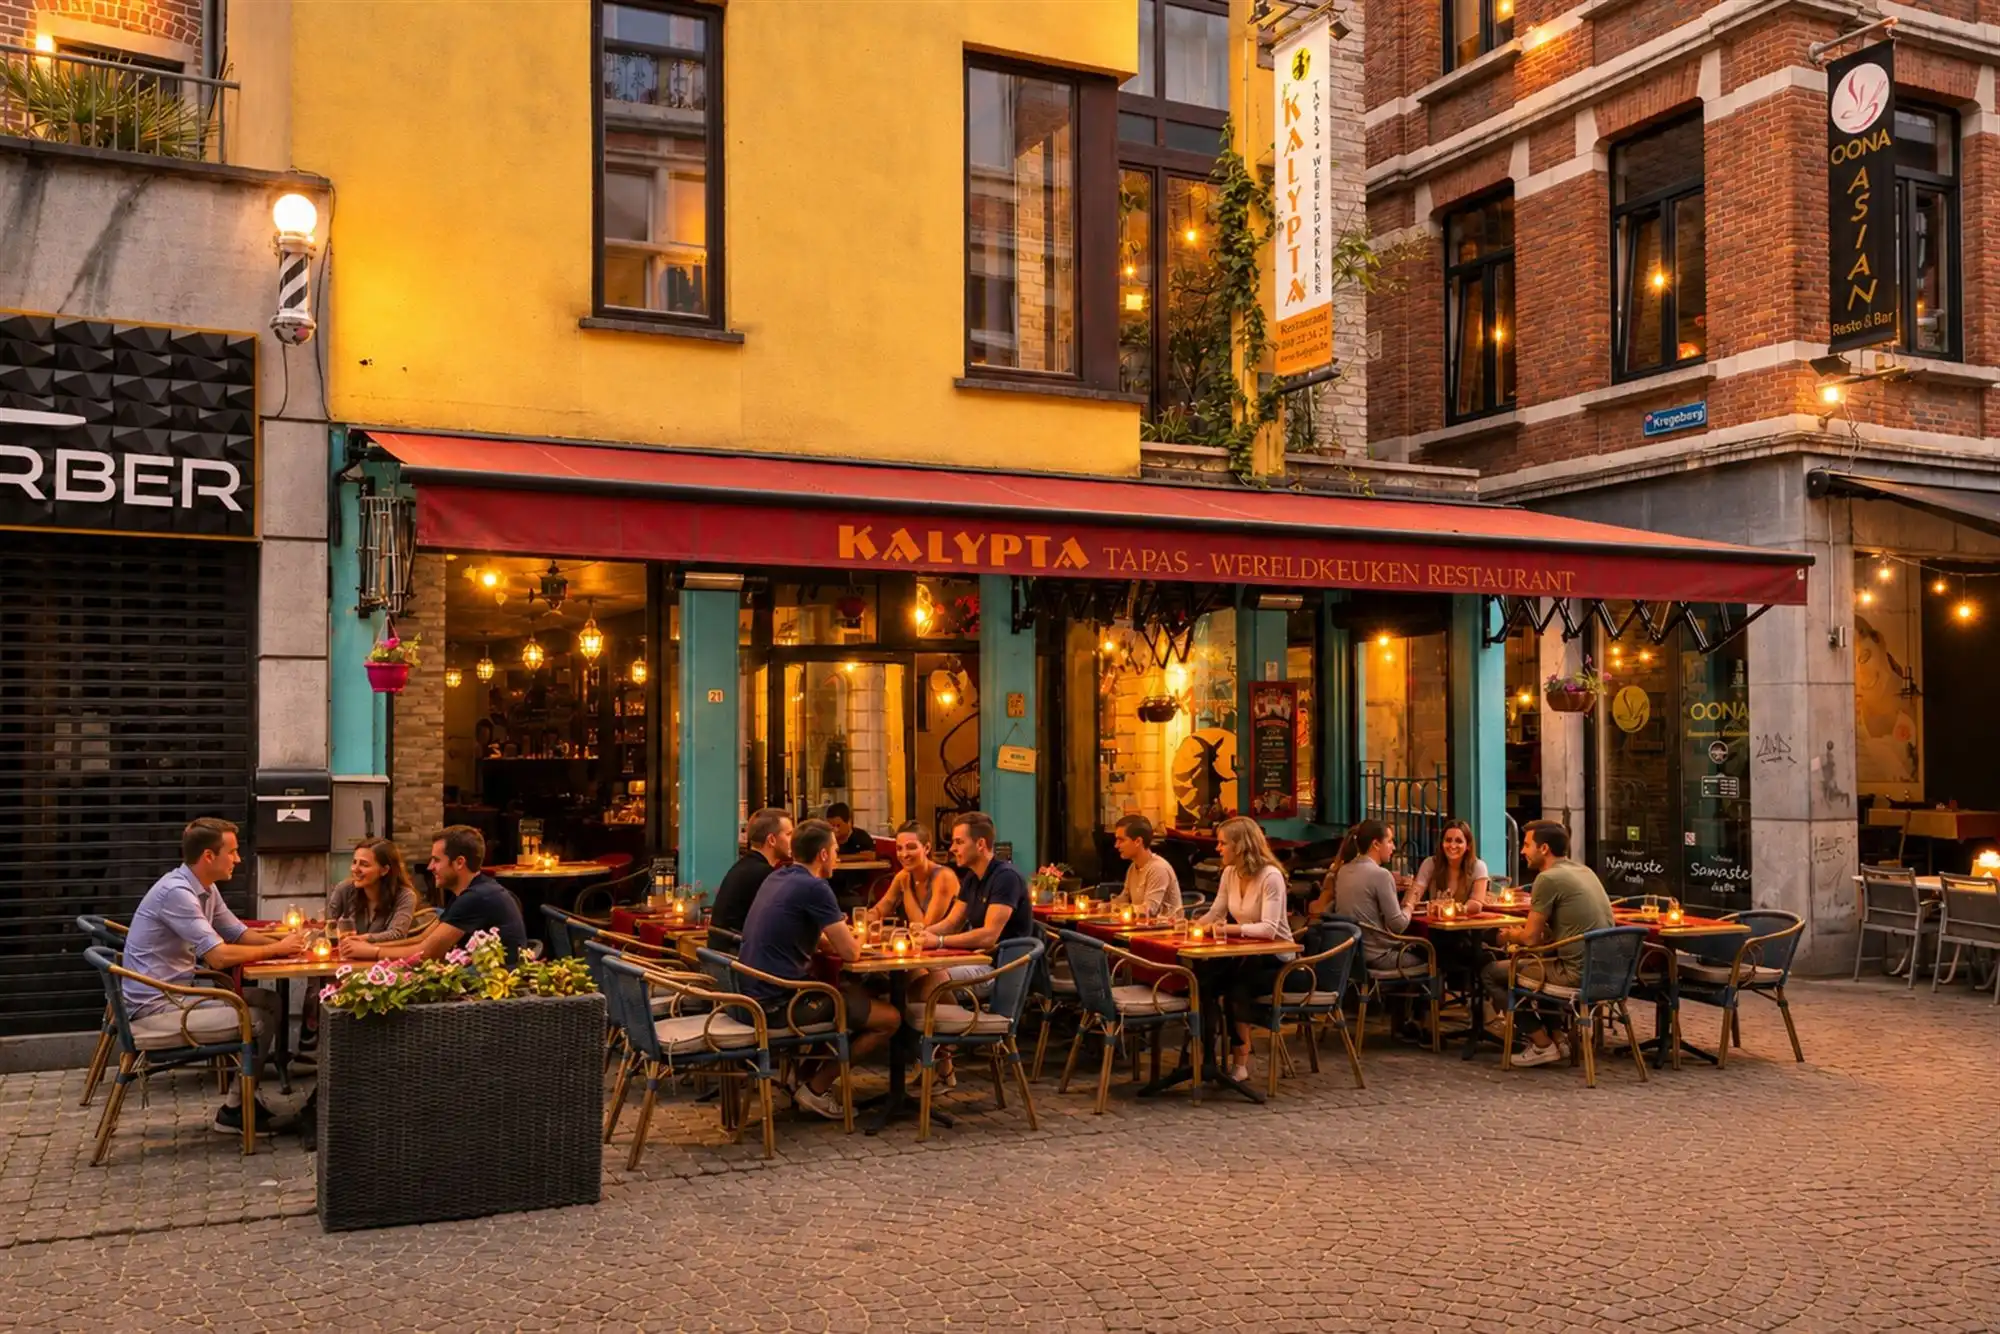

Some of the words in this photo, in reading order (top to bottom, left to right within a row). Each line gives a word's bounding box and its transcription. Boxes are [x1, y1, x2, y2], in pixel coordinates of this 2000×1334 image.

[1830, 128, 1892, 165] OONA
[1283, 92, 1306, 308] KALYPTA
[1847, 165, 1878, 311] ASIAN
[1832, 318, 1862, 336] Resto
[1874, 311, 1894, 326] Bar
[0, 444, 243, 512] RBER
[838, 525, 1091, 570] KALYPTA
[1102, 548, 1189, 574] TAPAS
[1210, 553, 1420, 584] WERELDKEUKEN
[1428, 564, 1576, 592] RESTAURANT
[710, 691, 721, 702] 21
[1690, 702, 1749, 720] OONA
[1606, 856, 1664, 874] Namaste
